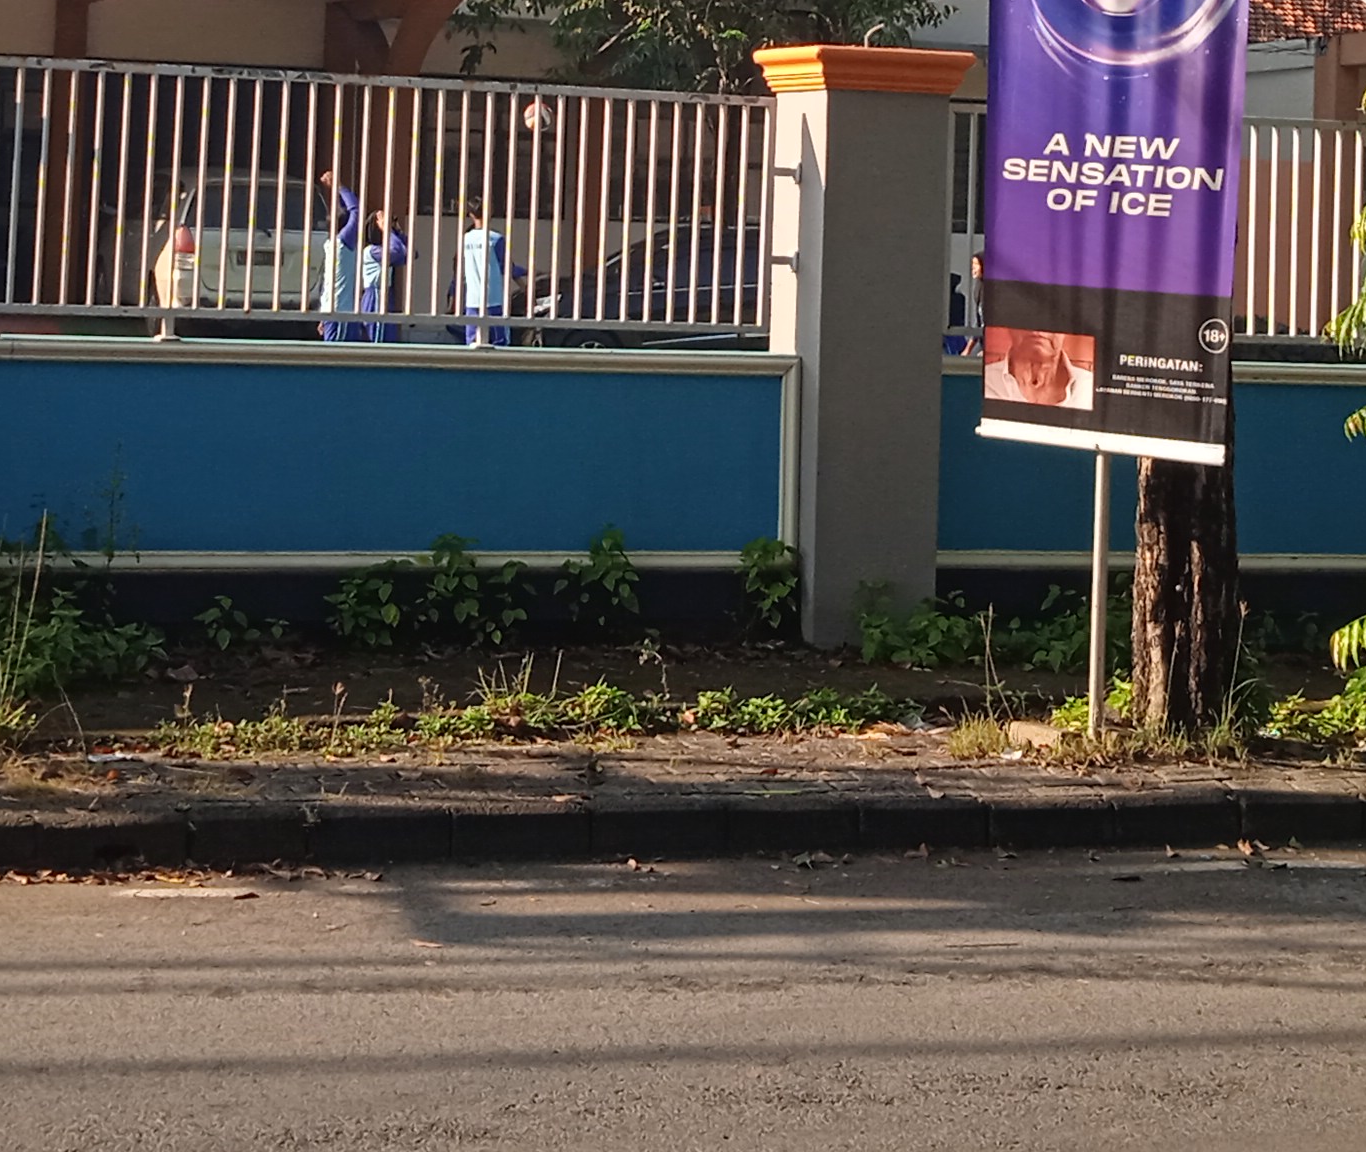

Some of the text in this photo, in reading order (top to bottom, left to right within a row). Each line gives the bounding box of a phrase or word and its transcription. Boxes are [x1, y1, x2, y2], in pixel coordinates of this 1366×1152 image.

[1042, 132, 1180, 160] A NEW
[1002, 158, 1225, 191] SENSATION
[1046, 188, 1173, 217] OF ICE
[1203, 329, 1226, 343] 18+
